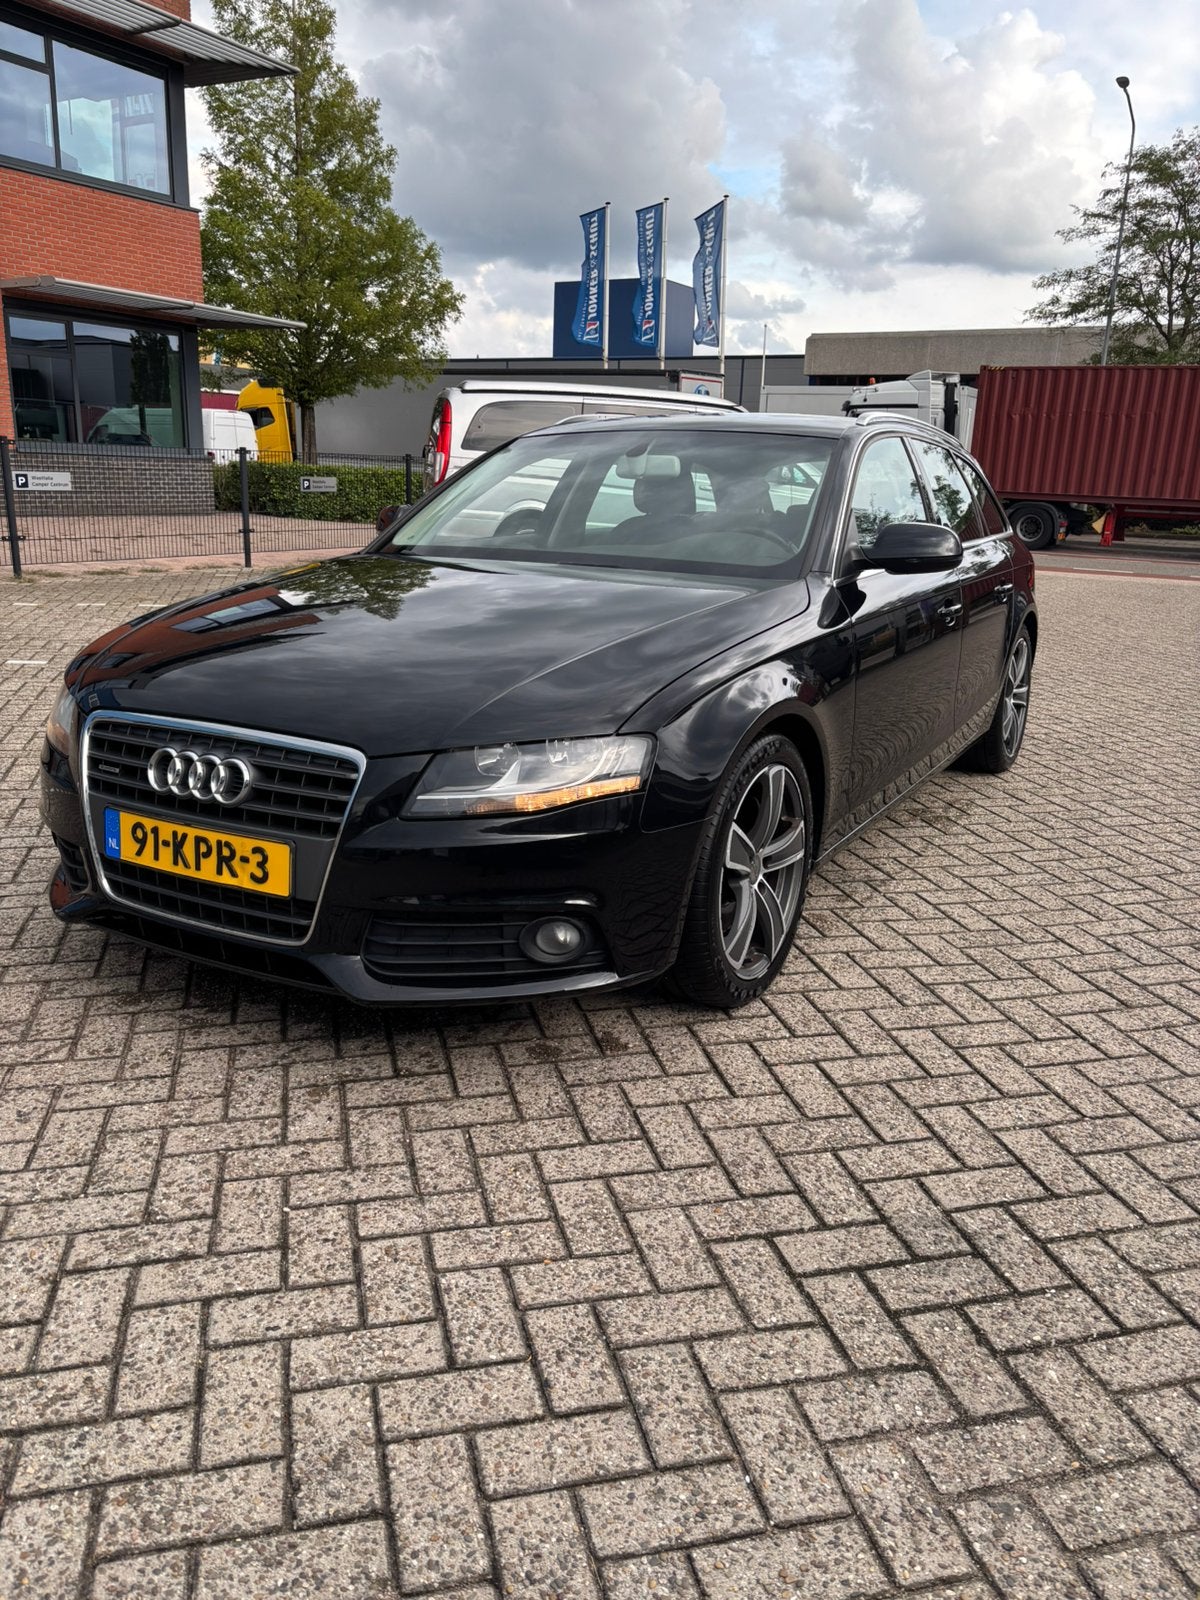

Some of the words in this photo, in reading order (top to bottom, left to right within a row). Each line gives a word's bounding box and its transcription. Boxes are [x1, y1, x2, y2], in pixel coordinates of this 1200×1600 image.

[18, 476, 26, 486] P
[109, 837, 119, 850] NL
[131, 822, 270, 885] 91-KPR-3
